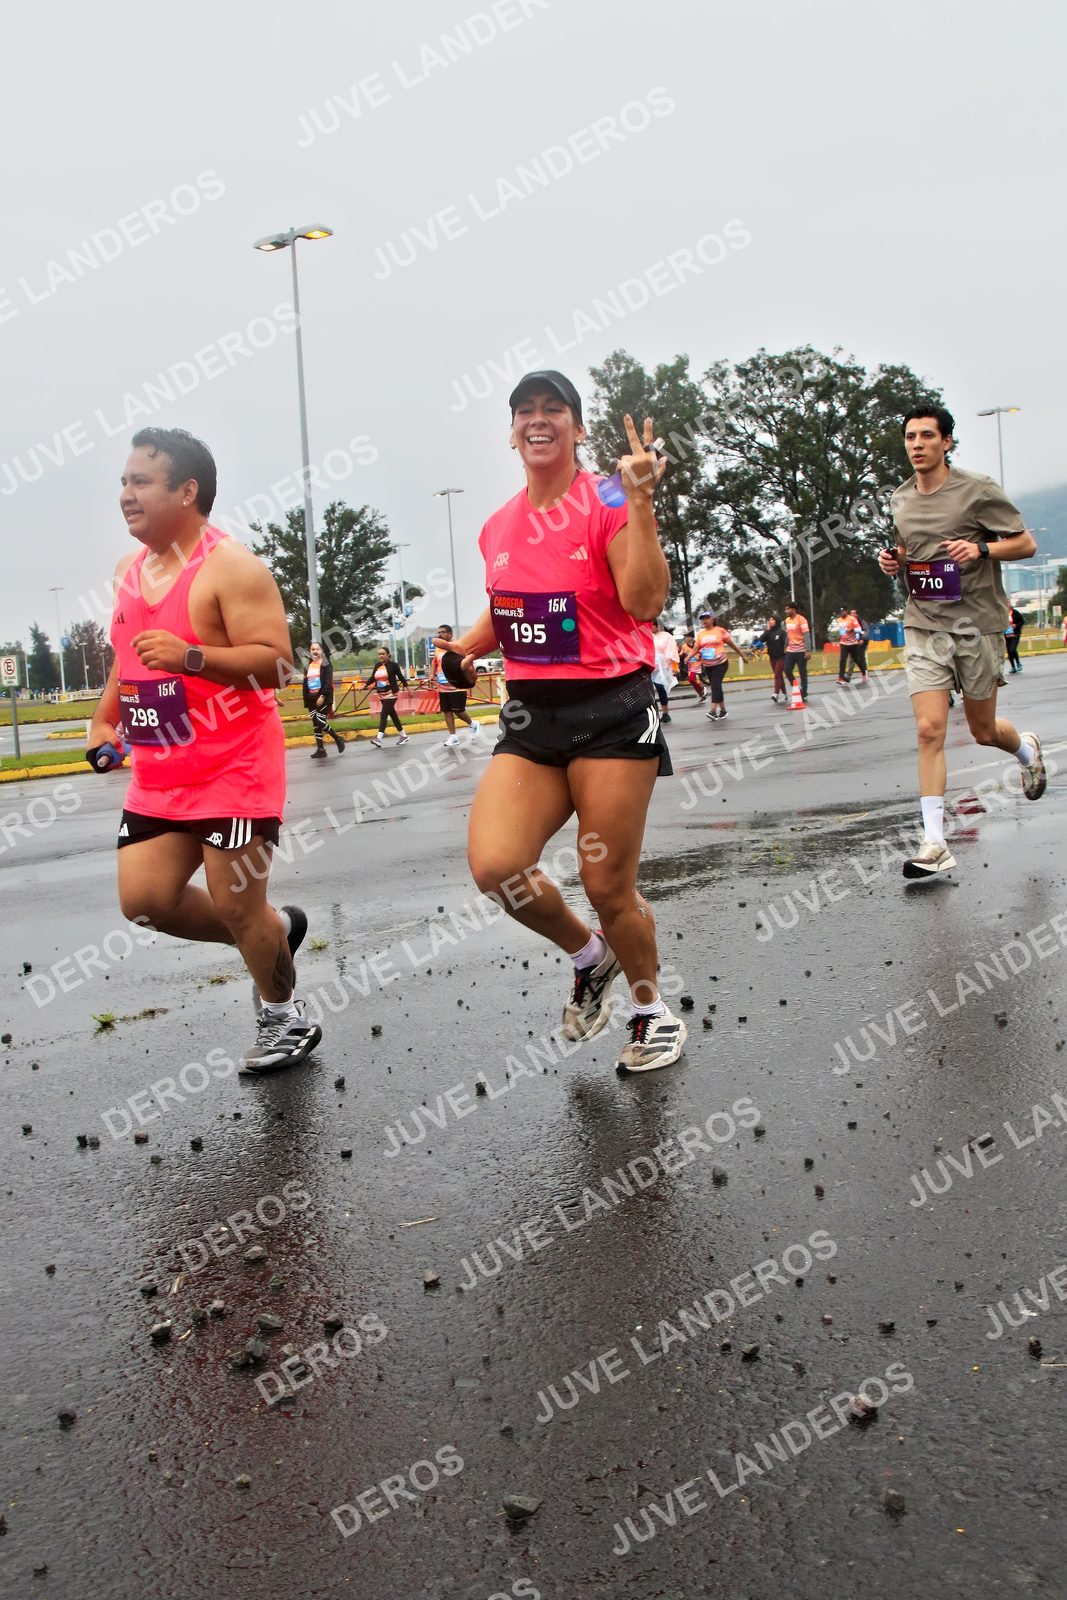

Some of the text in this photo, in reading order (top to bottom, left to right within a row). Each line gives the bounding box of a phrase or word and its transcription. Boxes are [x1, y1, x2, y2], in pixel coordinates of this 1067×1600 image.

[919, 577, 943, 589] 710
[494, 596, 524, 609] CARRERA
[548, 598, 567, 612] 15K
[510, 622, 547, 644] 195
[157, 681, 176, 697] 15K
[129, 708, 159, 727] 298
